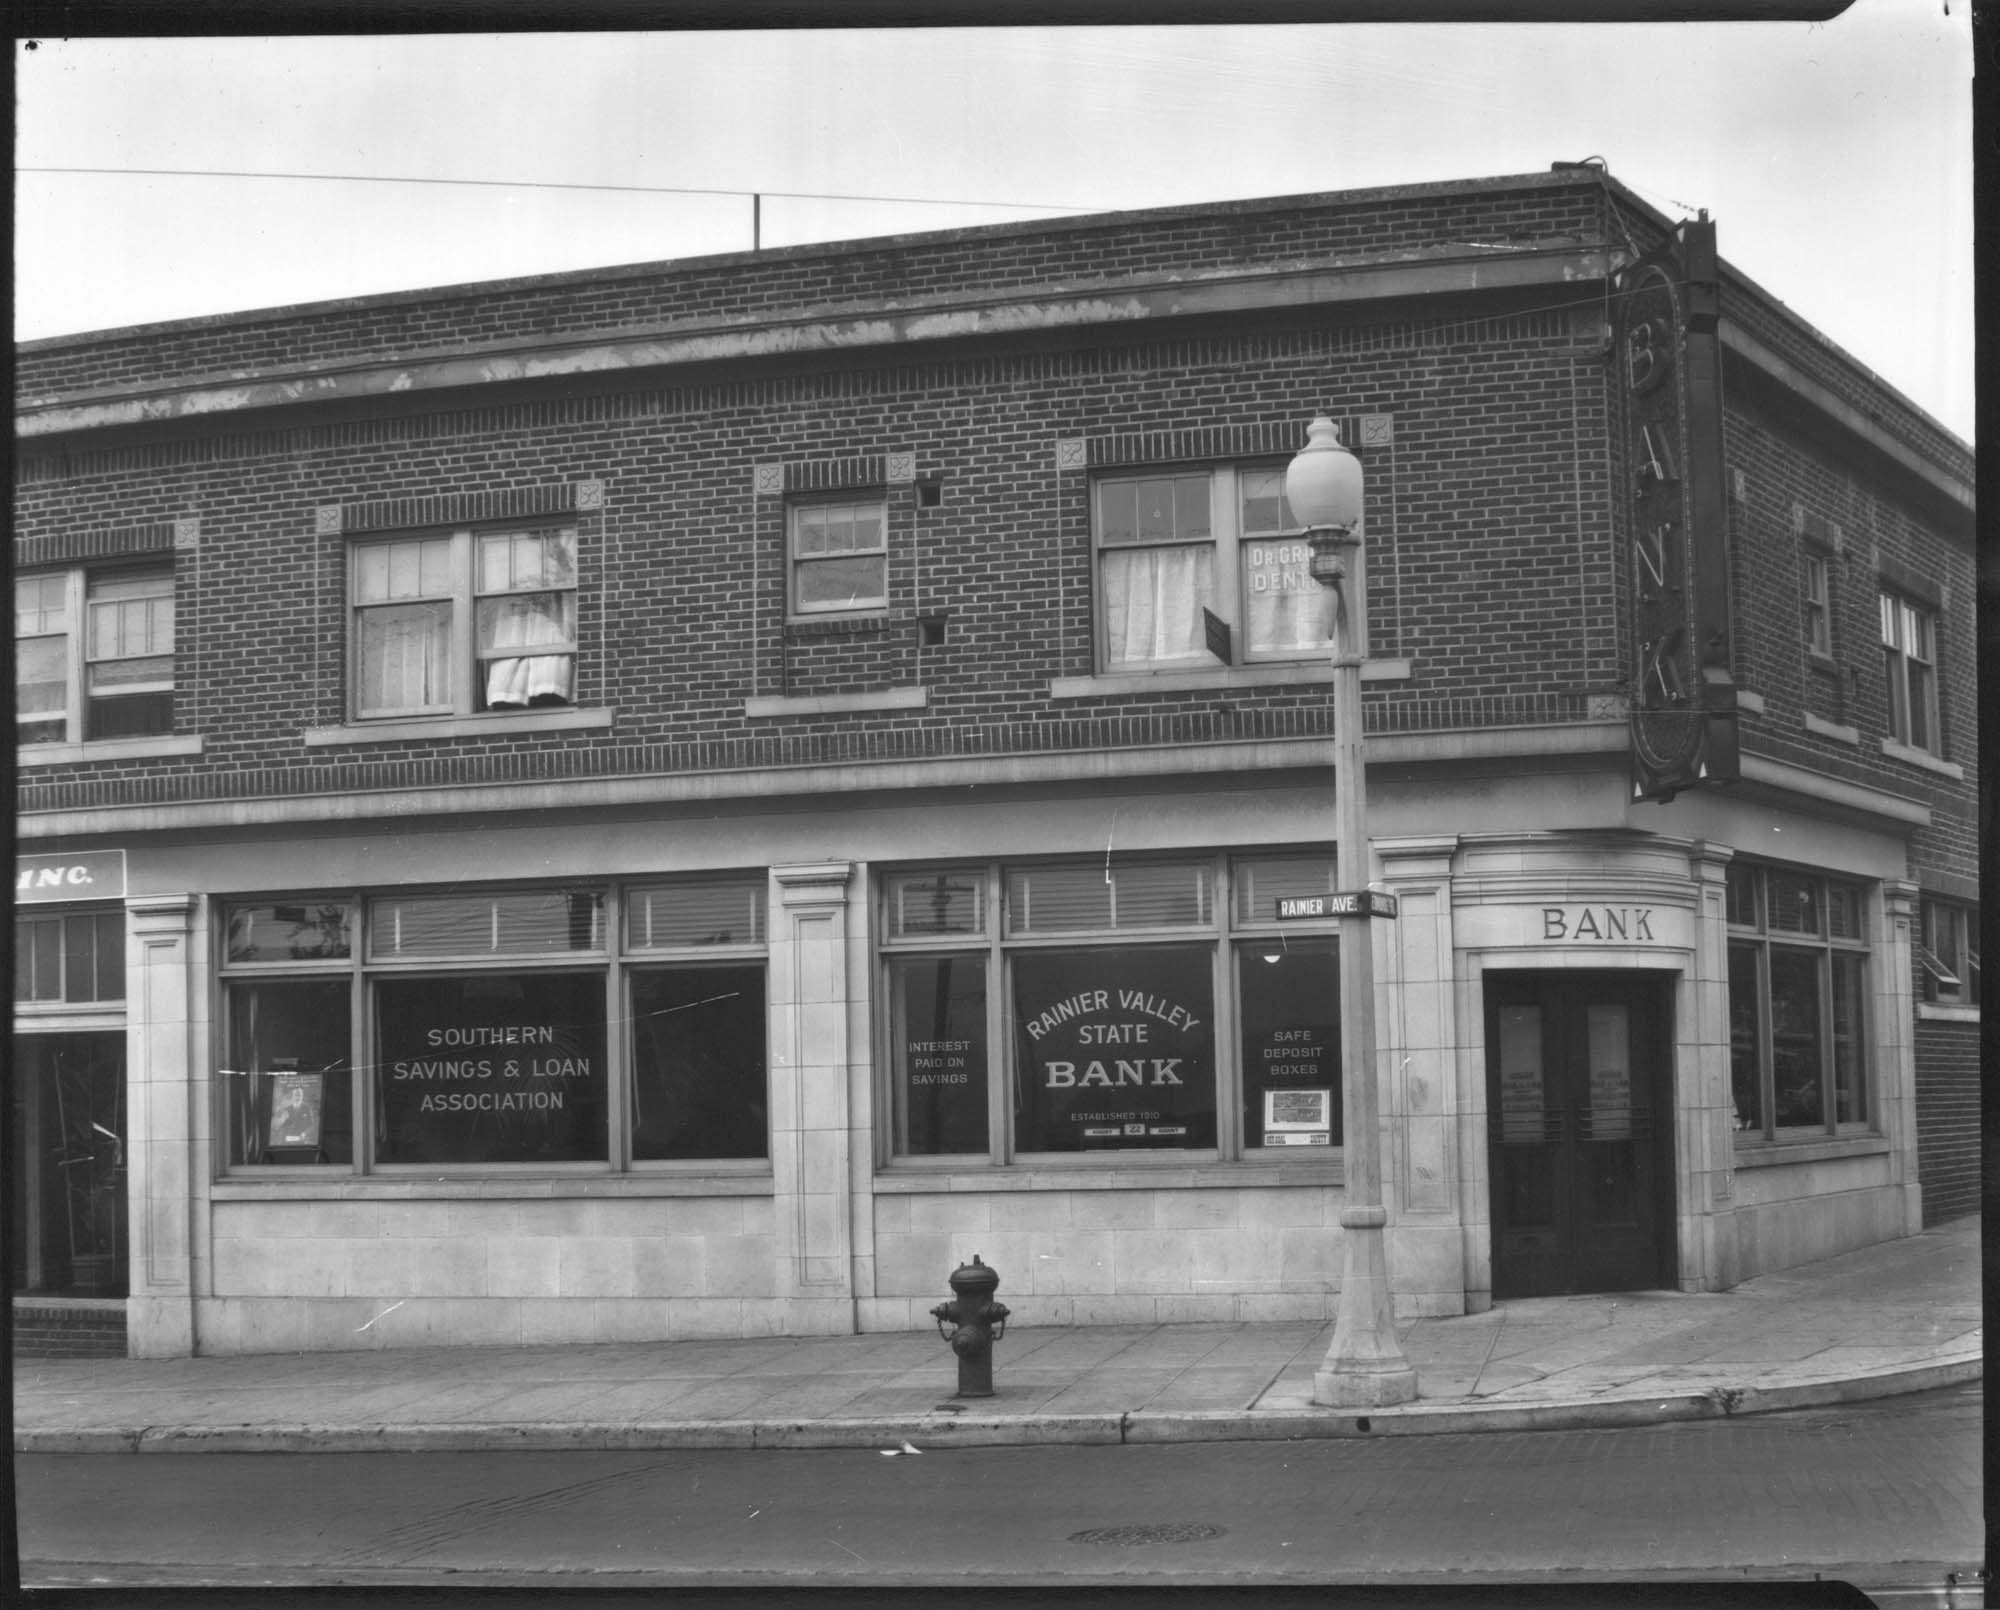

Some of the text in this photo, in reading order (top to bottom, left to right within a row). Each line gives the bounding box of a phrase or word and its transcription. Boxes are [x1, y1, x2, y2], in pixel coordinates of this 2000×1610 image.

[1627, 318, 1686, 706] BANK
[16, 865, 93, 890] INC.
[1280, 898, 1324, 917] RAINIER
[1331, 896, 1358, 913] AVE.
[1542, 907, 1655, 940] BANK
[1026, 989, 1201, 1041] RAINIER VALLEY
[426, 1025, 554, 1047] SOUTHERN
[1078, 1023, 1149, 1045] STATE
[1274, 1029, 1312, 1042] SAFE
[909, 1039, 971, 1053] INTEREST
[1263, 1046, 1324, 1059] DEPOSIT
[393, 1057, 591, 1081] SAVINGS & LOAN
[914, 1056, 965, 1069] PAID ON
[1045, 1058, 1184, 1088] BANK
[1270, 1063, 1318, 1076] BOXES
[912, 1073, 968, 1085] SAVINGS
[419, 1091, 564, 1113] ASSOCIATION
[1071, 1111, 1136, 1122] ESTABLISHED
